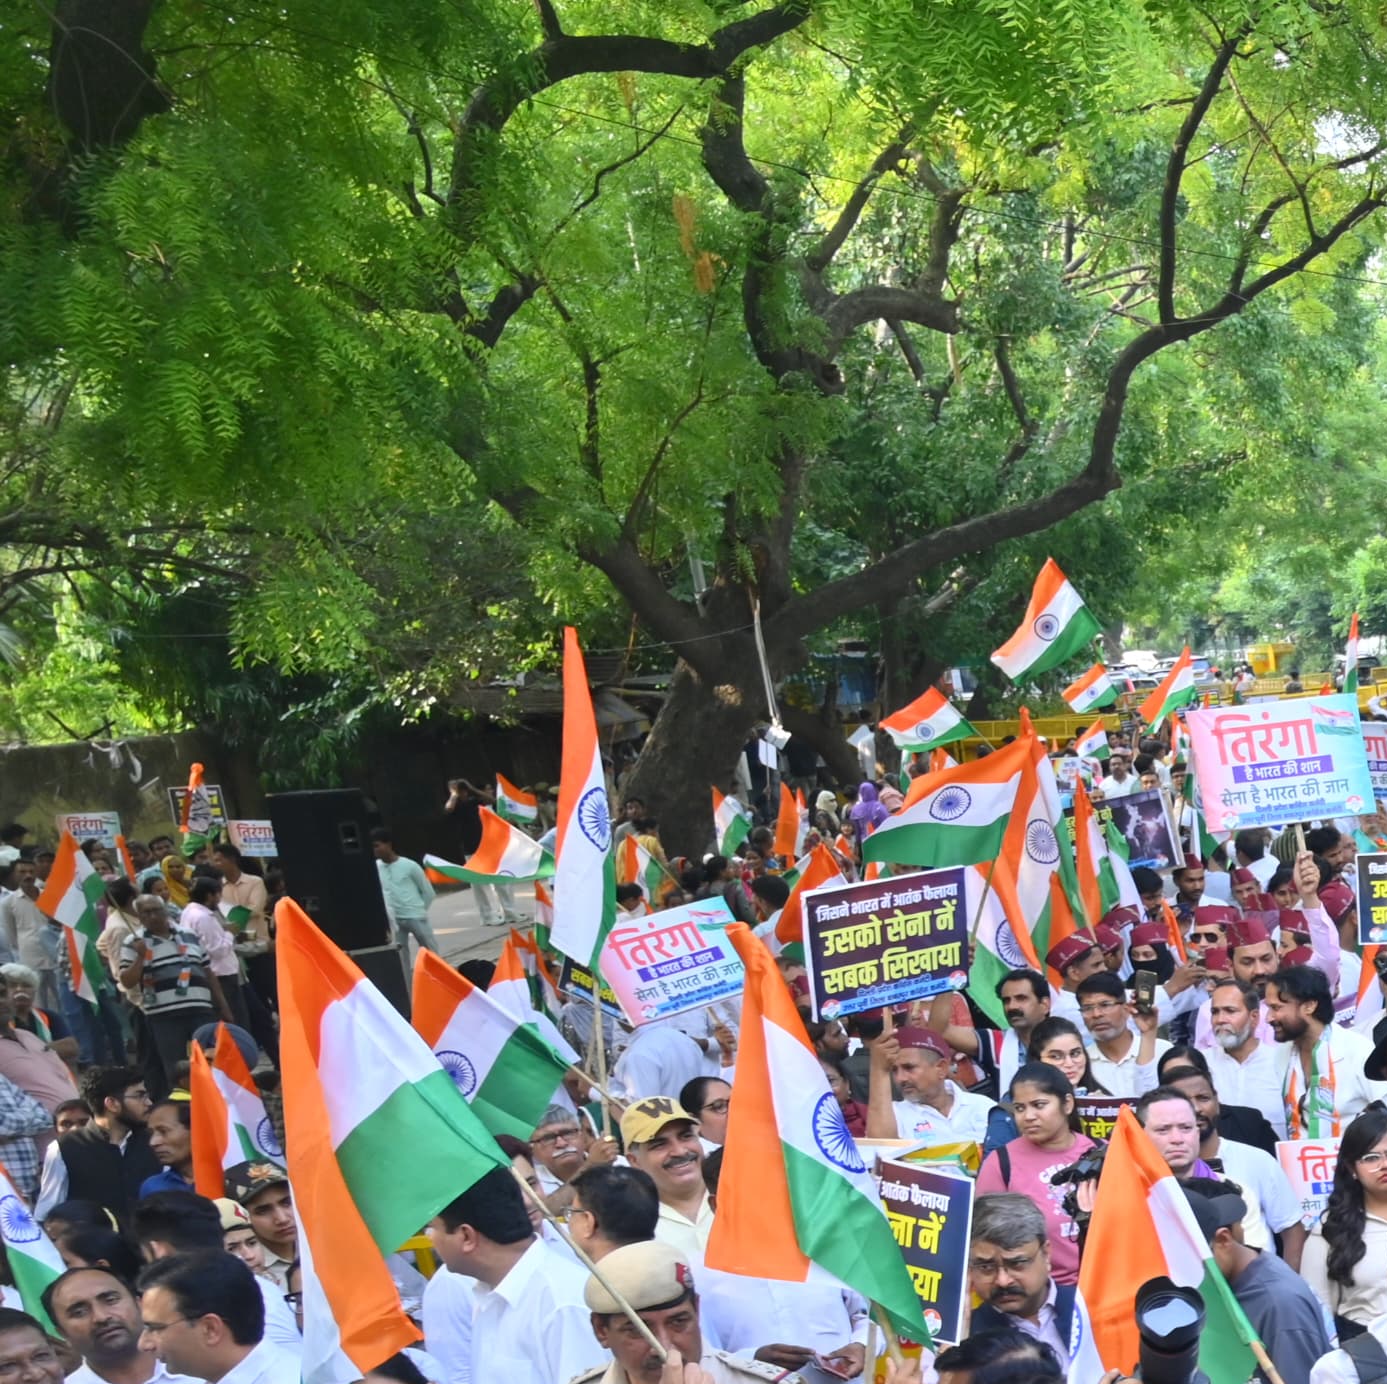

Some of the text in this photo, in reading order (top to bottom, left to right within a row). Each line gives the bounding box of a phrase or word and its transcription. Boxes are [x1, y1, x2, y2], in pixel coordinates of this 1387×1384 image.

[1211, 712, 1319, 765] तिरंगा
[1244, 760, 1321, 781] है भारत की शान
[1220, 778, 1349, 807] सेना है भारत की जान
[815, 883, 958, 922] जिसने भारत में आतंक फैलाया
[608, 921, 707, 970] तिरंगा
[819, 914, 882, 957] उसको
[884, 909, 932, 943] सेना
[633, 986, 659, 1002] सेना
[660, 980, 671, 996] है
[672, 974, 700, 991] भारत
[701, 966, 720, 983] की
[721, 961, 743, 977] जान
[821, 942, 961, 995] सबक सिखाया
[636, 1098, 673, 1119] W
[880, 1180, 950, 1212] आतंक फैलाया
